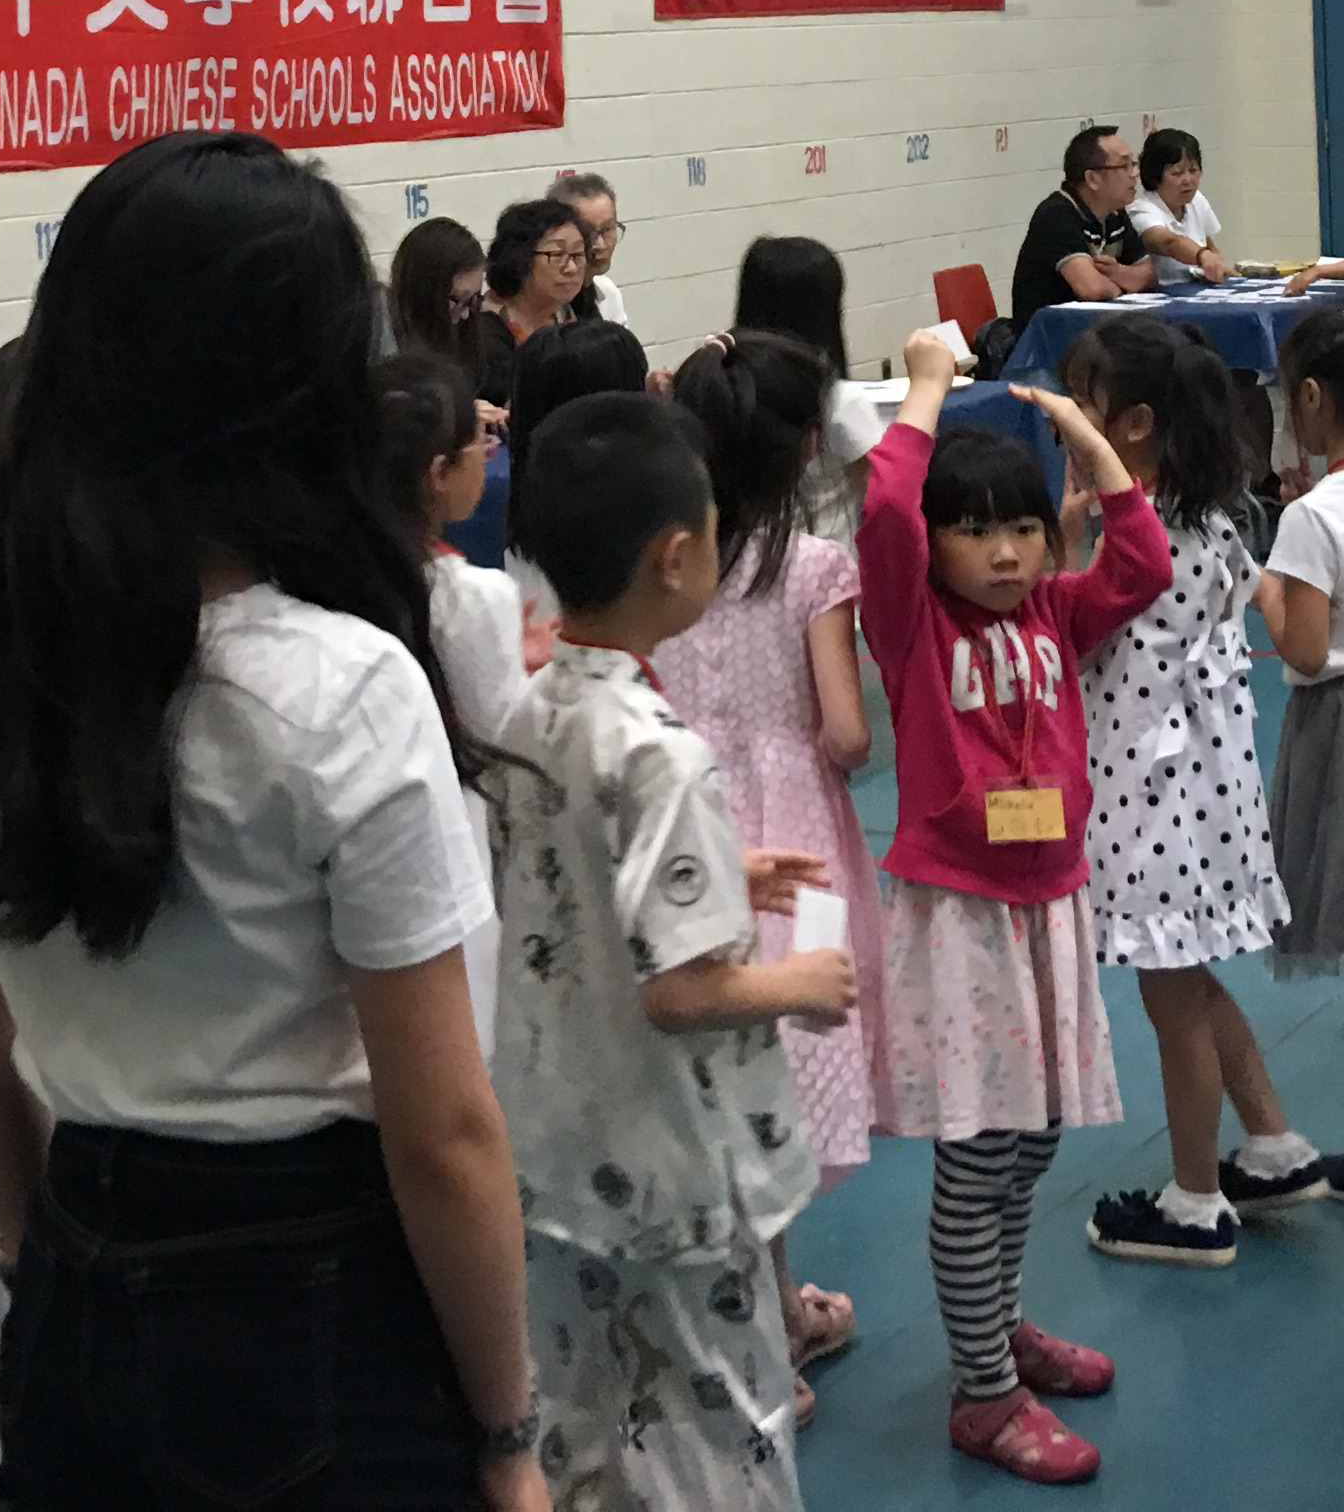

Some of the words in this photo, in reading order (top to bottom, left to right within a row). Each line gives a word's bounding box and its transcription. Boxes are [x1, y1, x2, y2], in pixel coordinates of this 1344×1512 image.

[109, 57, 238, 141] CHINESE
[252, 54, 377, 130] SCHOOLS
[390, 50, 550, 122] ASSOCIATION
[805, 145, 826, 174] 201
[906, 133, 930, 163] 202
[686, 156, 707, 187] 118
[405, 183, 430, 219] 115
[951, 618, 1063, 712] GAP
